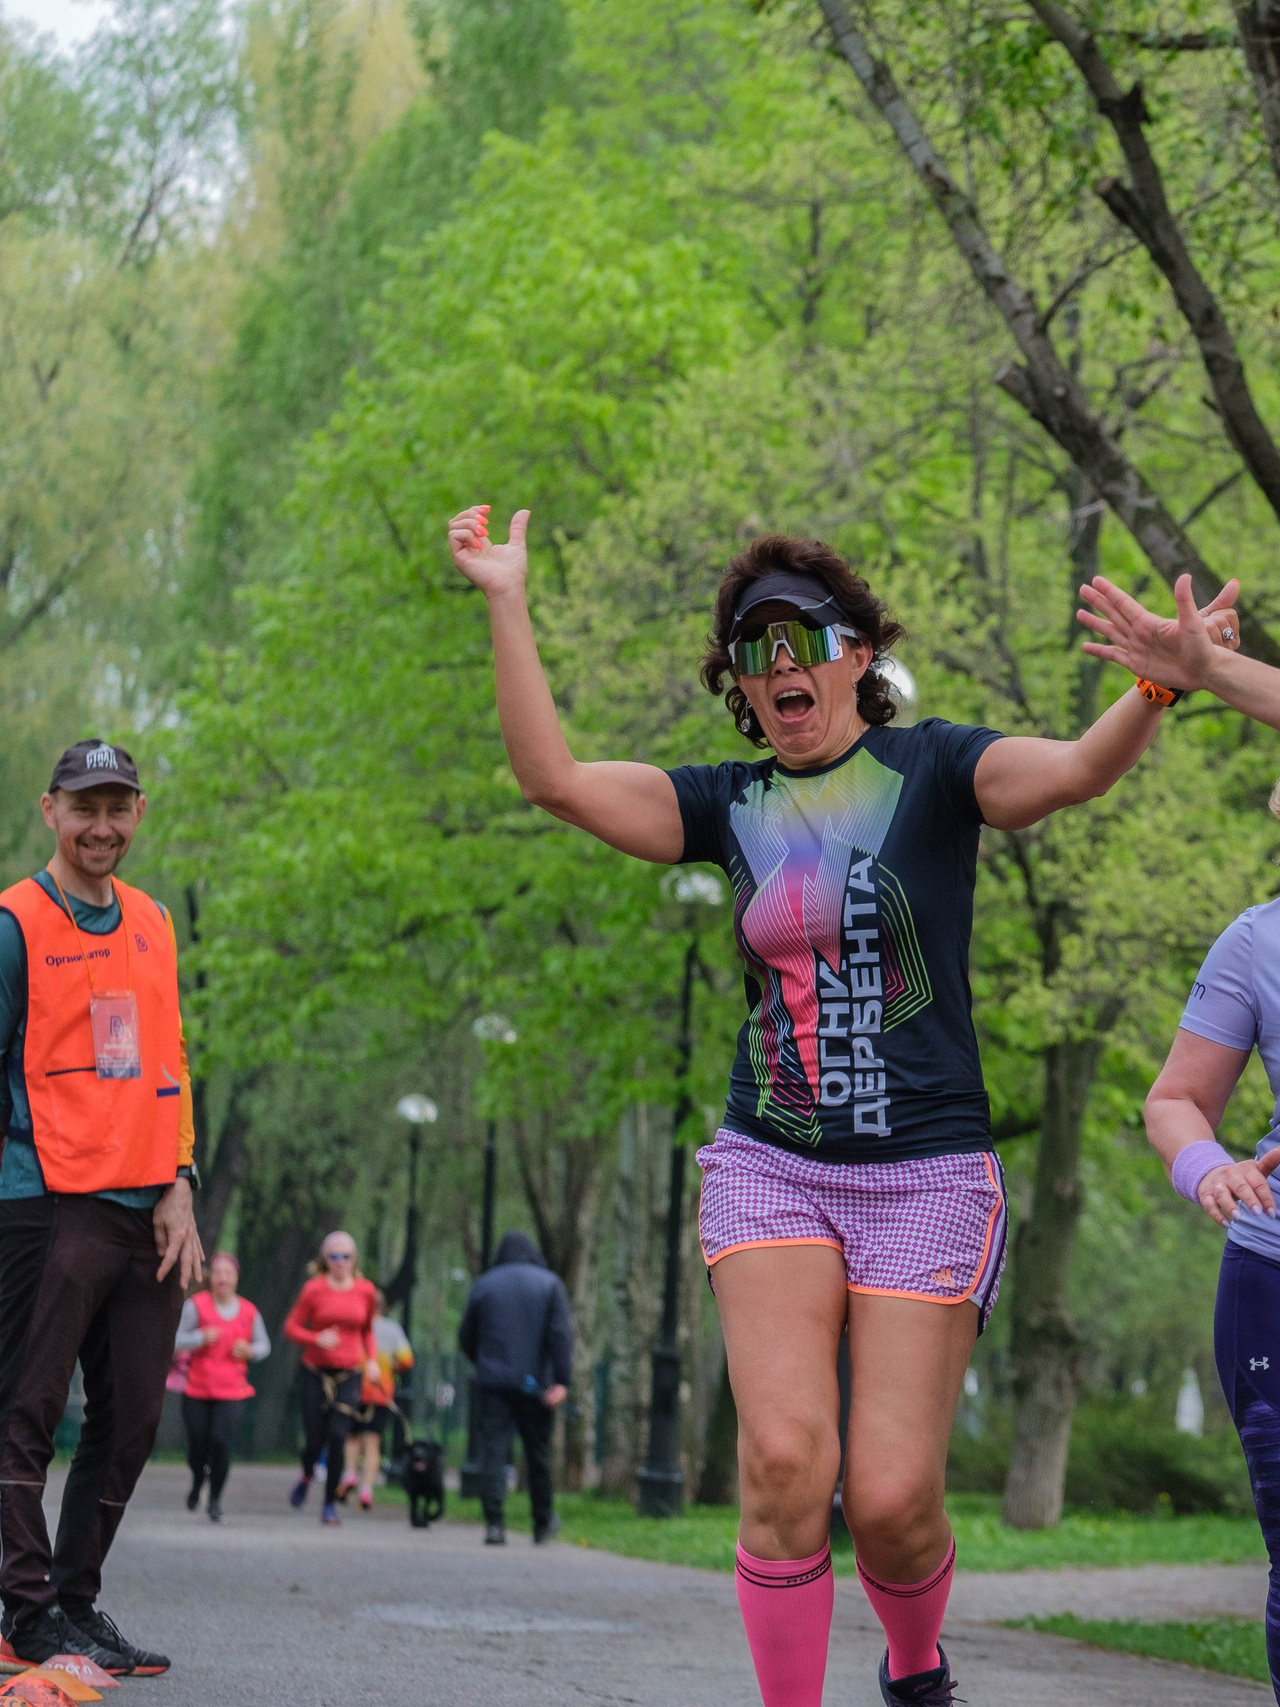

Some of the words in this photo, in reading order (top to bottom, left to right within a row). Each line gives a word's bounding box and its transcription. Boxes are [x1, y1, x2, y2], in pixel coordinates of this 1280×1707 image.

[45, 948, 111, 968] Органиатор
[843, 855, 892, 1138] ДЕРБЕНТА
[819, 960, 851, 1107] ОГНИ
